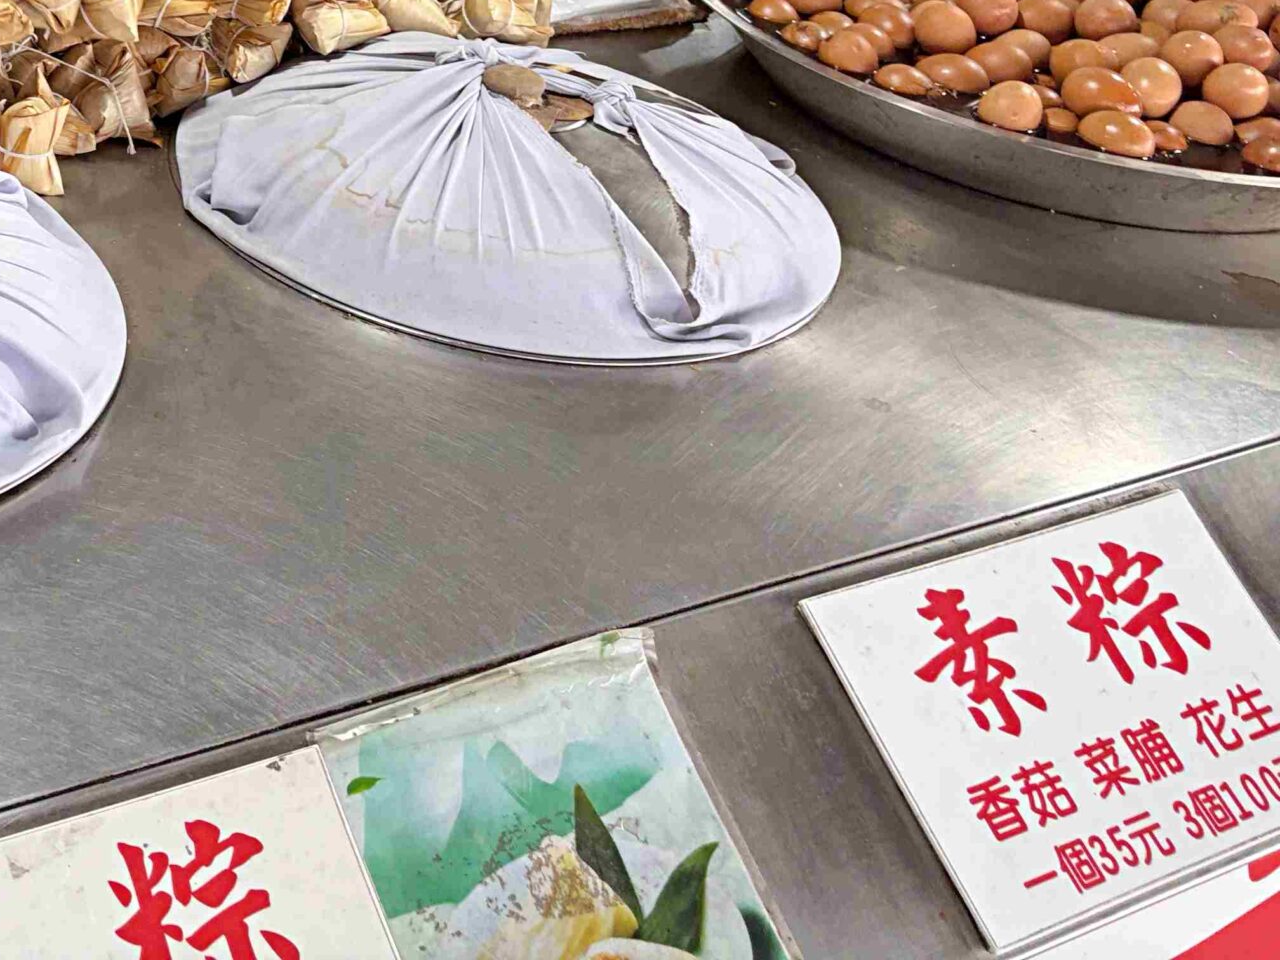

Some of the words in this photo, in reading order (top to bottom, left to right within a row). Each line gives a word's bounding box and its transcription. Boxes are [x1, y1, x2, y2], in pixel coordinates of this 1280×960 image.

[913, 541, 1212, 738] 素粽
[967, 759, 1079, 842] 香菇
[1074, 718, 1184, 800] 菜脯
[1180, 684, 1280, 757] 花生
[1023, 811, 1176, 895] 一個35元
[1172, 757, 1280, 840] 3個100
